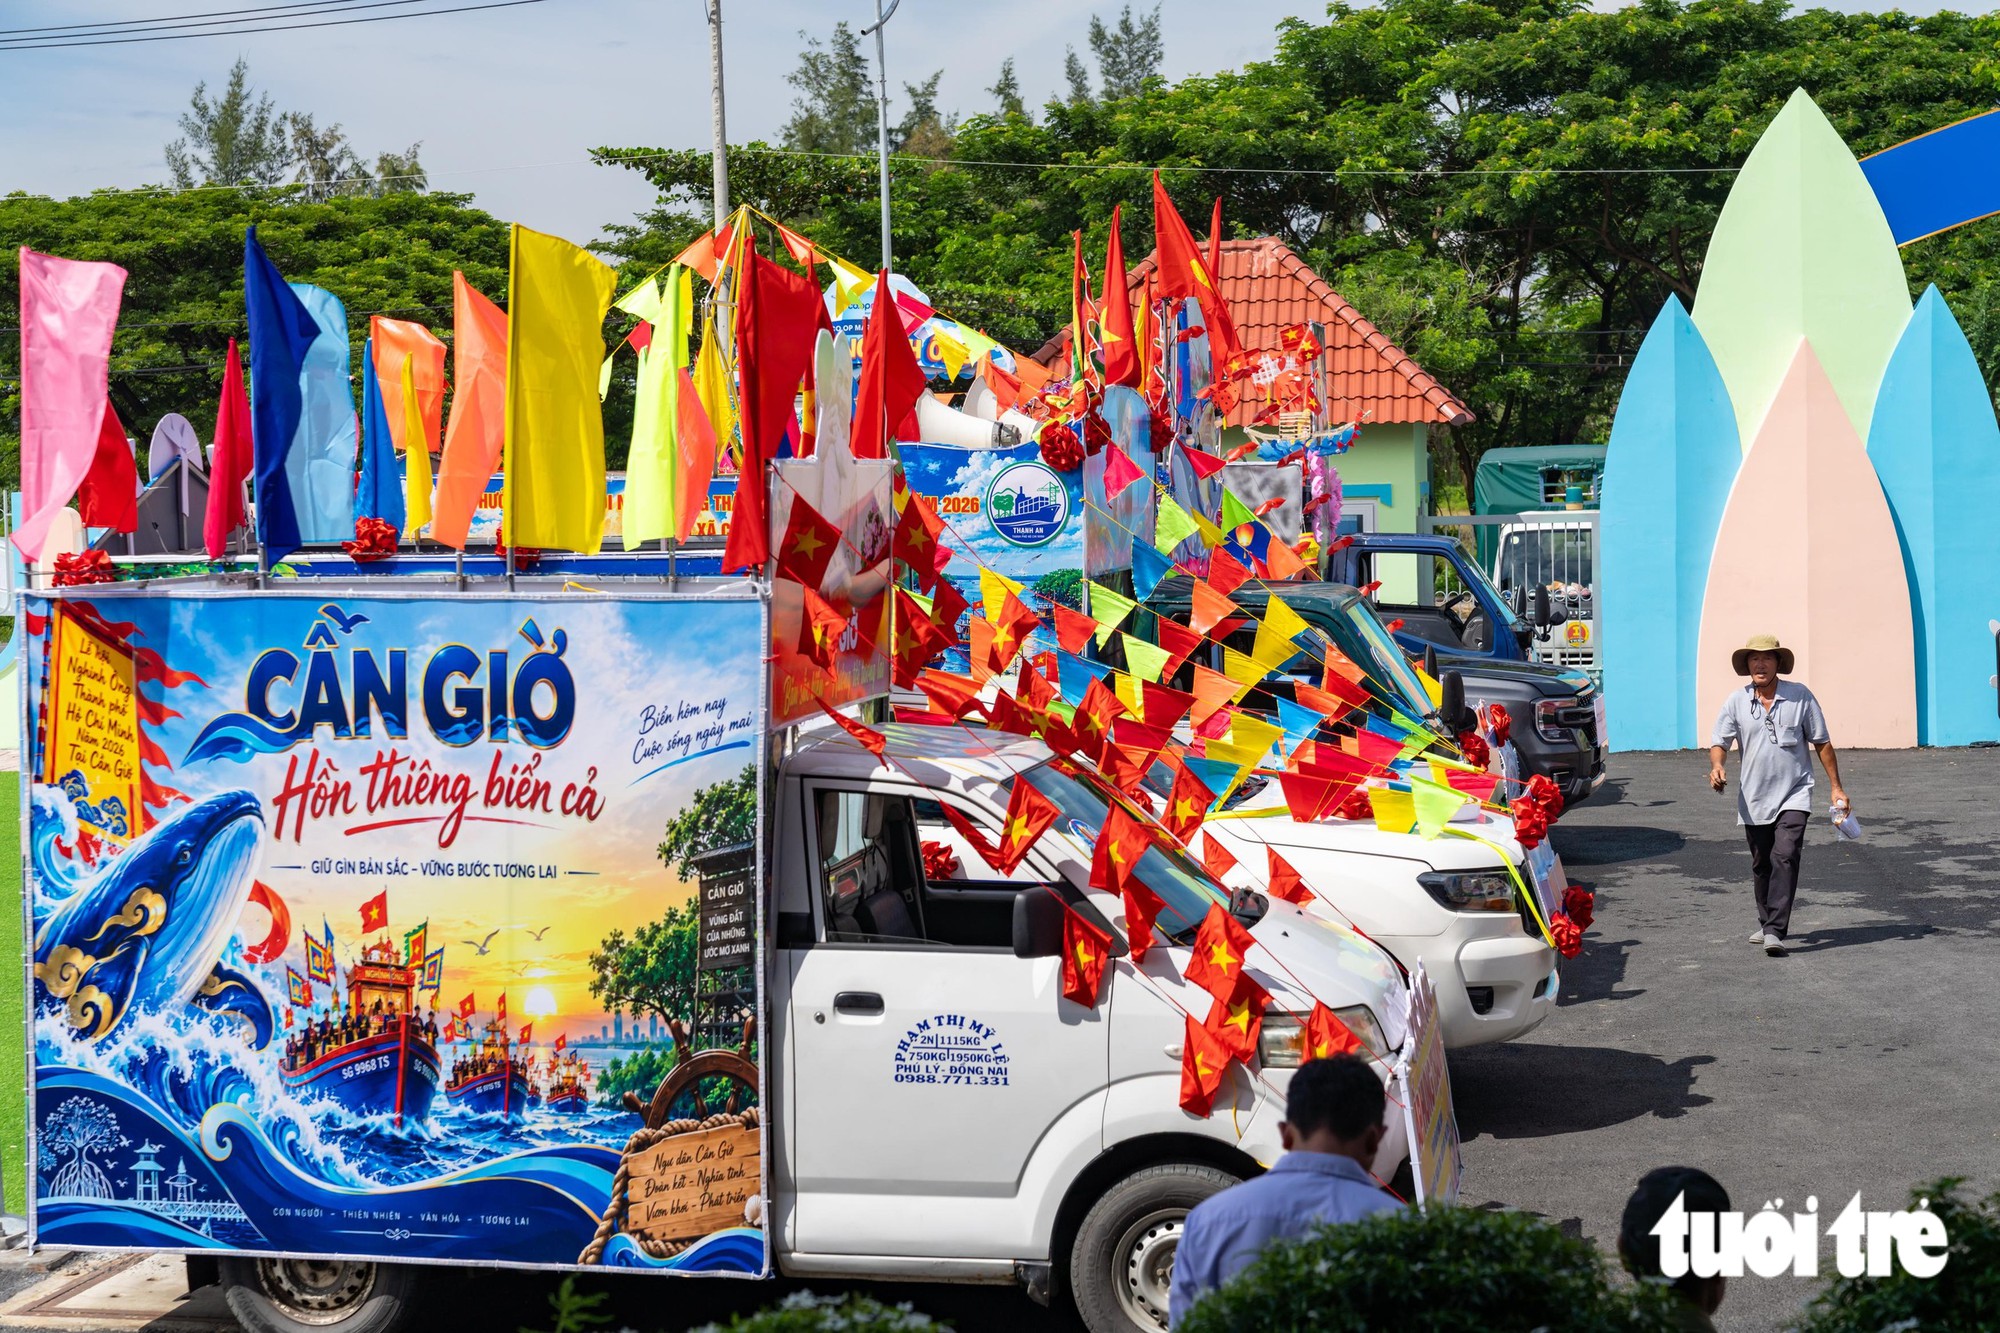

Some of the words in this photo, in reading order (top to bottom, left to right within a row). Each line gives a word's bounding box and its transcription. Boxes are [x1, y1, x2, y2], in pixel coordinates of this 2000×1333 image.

[942, 496, 980, 513] 2026
[697, 520, 716, 535] XÃ
[68, 656, 106, 682] Nghinh
[110, 670, 131, 700] Ông
[245, 604, 408, 740] CẦN
[420, 616, 576, 750] GIỜ
[73, 682, 106, 708] Thành
[108, 700, 129, 717] phố
[66, 702, 82, 722] Hồ
[85, 709, 105, 731] Chí
[107, 719, 135, 743] Minh
[638, 704, 674, 735] Biển
[676, 699, 701, 720] hôm
[704, 697, 728, 719] nay
[76, 727, 99, 747] Năm
[102, 737, 125, 758] 2026
[632, 738, 664, 764] Cuộc
[666, 730, 692, 756] sống
[695, 721, 725, 750] ngày
[729, 711, 753, 731] mai
[69, 743, 87, 765] Tại
[90, 751, 111, 773] Cần
[114, 759, 133, 781] Giờ
[272, 748, 357, 846] Hồn
[359, 748, 479, 849] thiêng
[483, 749, 553, 813] biển
[560, 765, 606, 823] cả
[311, 857, 333, 874] GIỮ
[335, 857, 356, 875] GÌN
[359, 856, 383, 875] BẢN
[386, 857, 409, 876] SẮC
[420, 859, 454, 877] VỮNG
[458, 860, 490, 878] BƯỚC
[493, 863, 536, 879] TƯƠNG
[539, 865, 557, 879] LAI
[727, 880, 745, 897] GIỜ
[709, 914, 728, 927] VÙNG
[729, 908, 744, 922] ĐẤT
[706, 930, 720, 942] CỦA
[721, 926, 746, 941] NHỮNG
[731, 942, 750, 955] XANH
[894, 1018, 932, 1063] PHẠM
[934, 1014, 966, 1030] THỊ
[920, 1035, 934, 1045] 2N
[940, 1036, 981, 1046] 1115KG
[341, 1065, 354, 1080] SG
[354, 1058, 377, 1075] 9968
[377, 1055, 390, 1069] TS
[896, 1062, 920, 1073] PHÚ
[949, 1062, 984, 1075] ĐỒNG
[987, 1066, 1008, 1076] NAI
[909, 1052, 946, 1061] 750KG
[951, 1052, 992, 1063] 1950KG
[894, 1074, 1010, 1086] 0988.771.331
[653, 1153, 674, 1176] Ngư
[675, 1150, 693, 1167] dân
[695, 1144, 715, 1162] Cần
[717, 1140, 735, 1158] Giờ
[644, 1178, 670, 1199] Đoàn
[672, 1174, 687, 1191] kết
[696, 1169, 726, 1191] Nghĩa
[727, 1163, 746, 1179] tình
[272, 1207, 291, 1217] CON
[294, 1207, 323, 1218] NGƯỜI
[342, 1209, 369, 1219] THIÊN
[372, 1210, 400, 1220] NHIÊN
[420, 1211, 438, 1222] VĂN
[441, 1212, 460, 1223] HÓA
[480, 1215, 511, 1225] TƯƠNG
[515, 1217, 530, 1226] LAI
[646, 1201, 668, 1222] Vươn
[670, 1199, 689, 1215] khơi
[699, 1191, 724, 1212] Phát
[725, 1187, 747, 1205] triển
